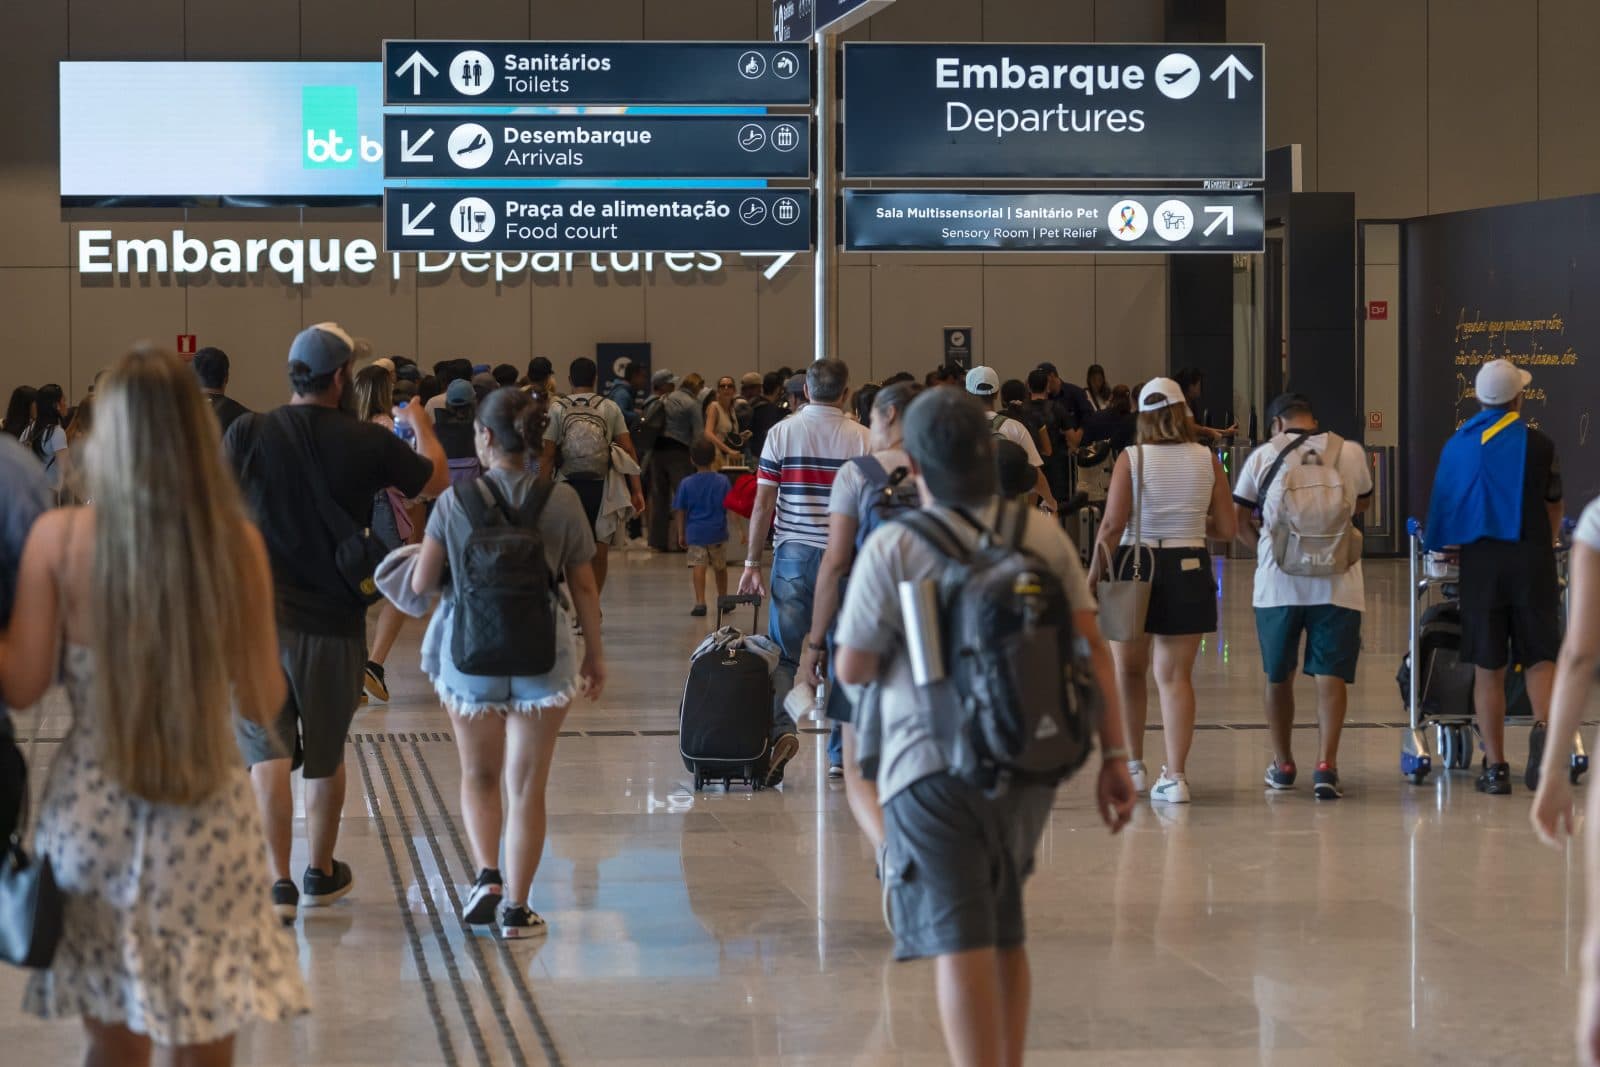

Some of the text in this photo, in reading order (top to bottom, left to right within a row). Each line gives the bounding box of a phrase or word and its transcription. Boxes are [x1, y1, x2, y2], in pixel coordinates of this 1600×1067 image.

[504, 54, 611, 71] Sanitários
[505, 76, 570, 92] Toilets
[936, 57, 1145, 95] Embarque
[946, 102, 1146, 137] Departures
[503, 127, 652, 147] Desembarque
[504, 149, 584, 166] Arrivals
[505, 200, 731, 221] Praça de alimentação
[876, 207, 904, 219] Sala
[907, 207, 1003, 219] Multissensorial
[1015, 207, 1073, 219] Sanitário
[1077, 207, 1099, 219] Pet
[506, 223, 618, 239] Food court
[941, 227, 991, 241] Sensory
[993, 227, 1029, 239] Room
[1039, 227, 1060, 239] Pet
[1063, 226, 1098, 239] Relief
[79, 230, 377, 283] Embarque
